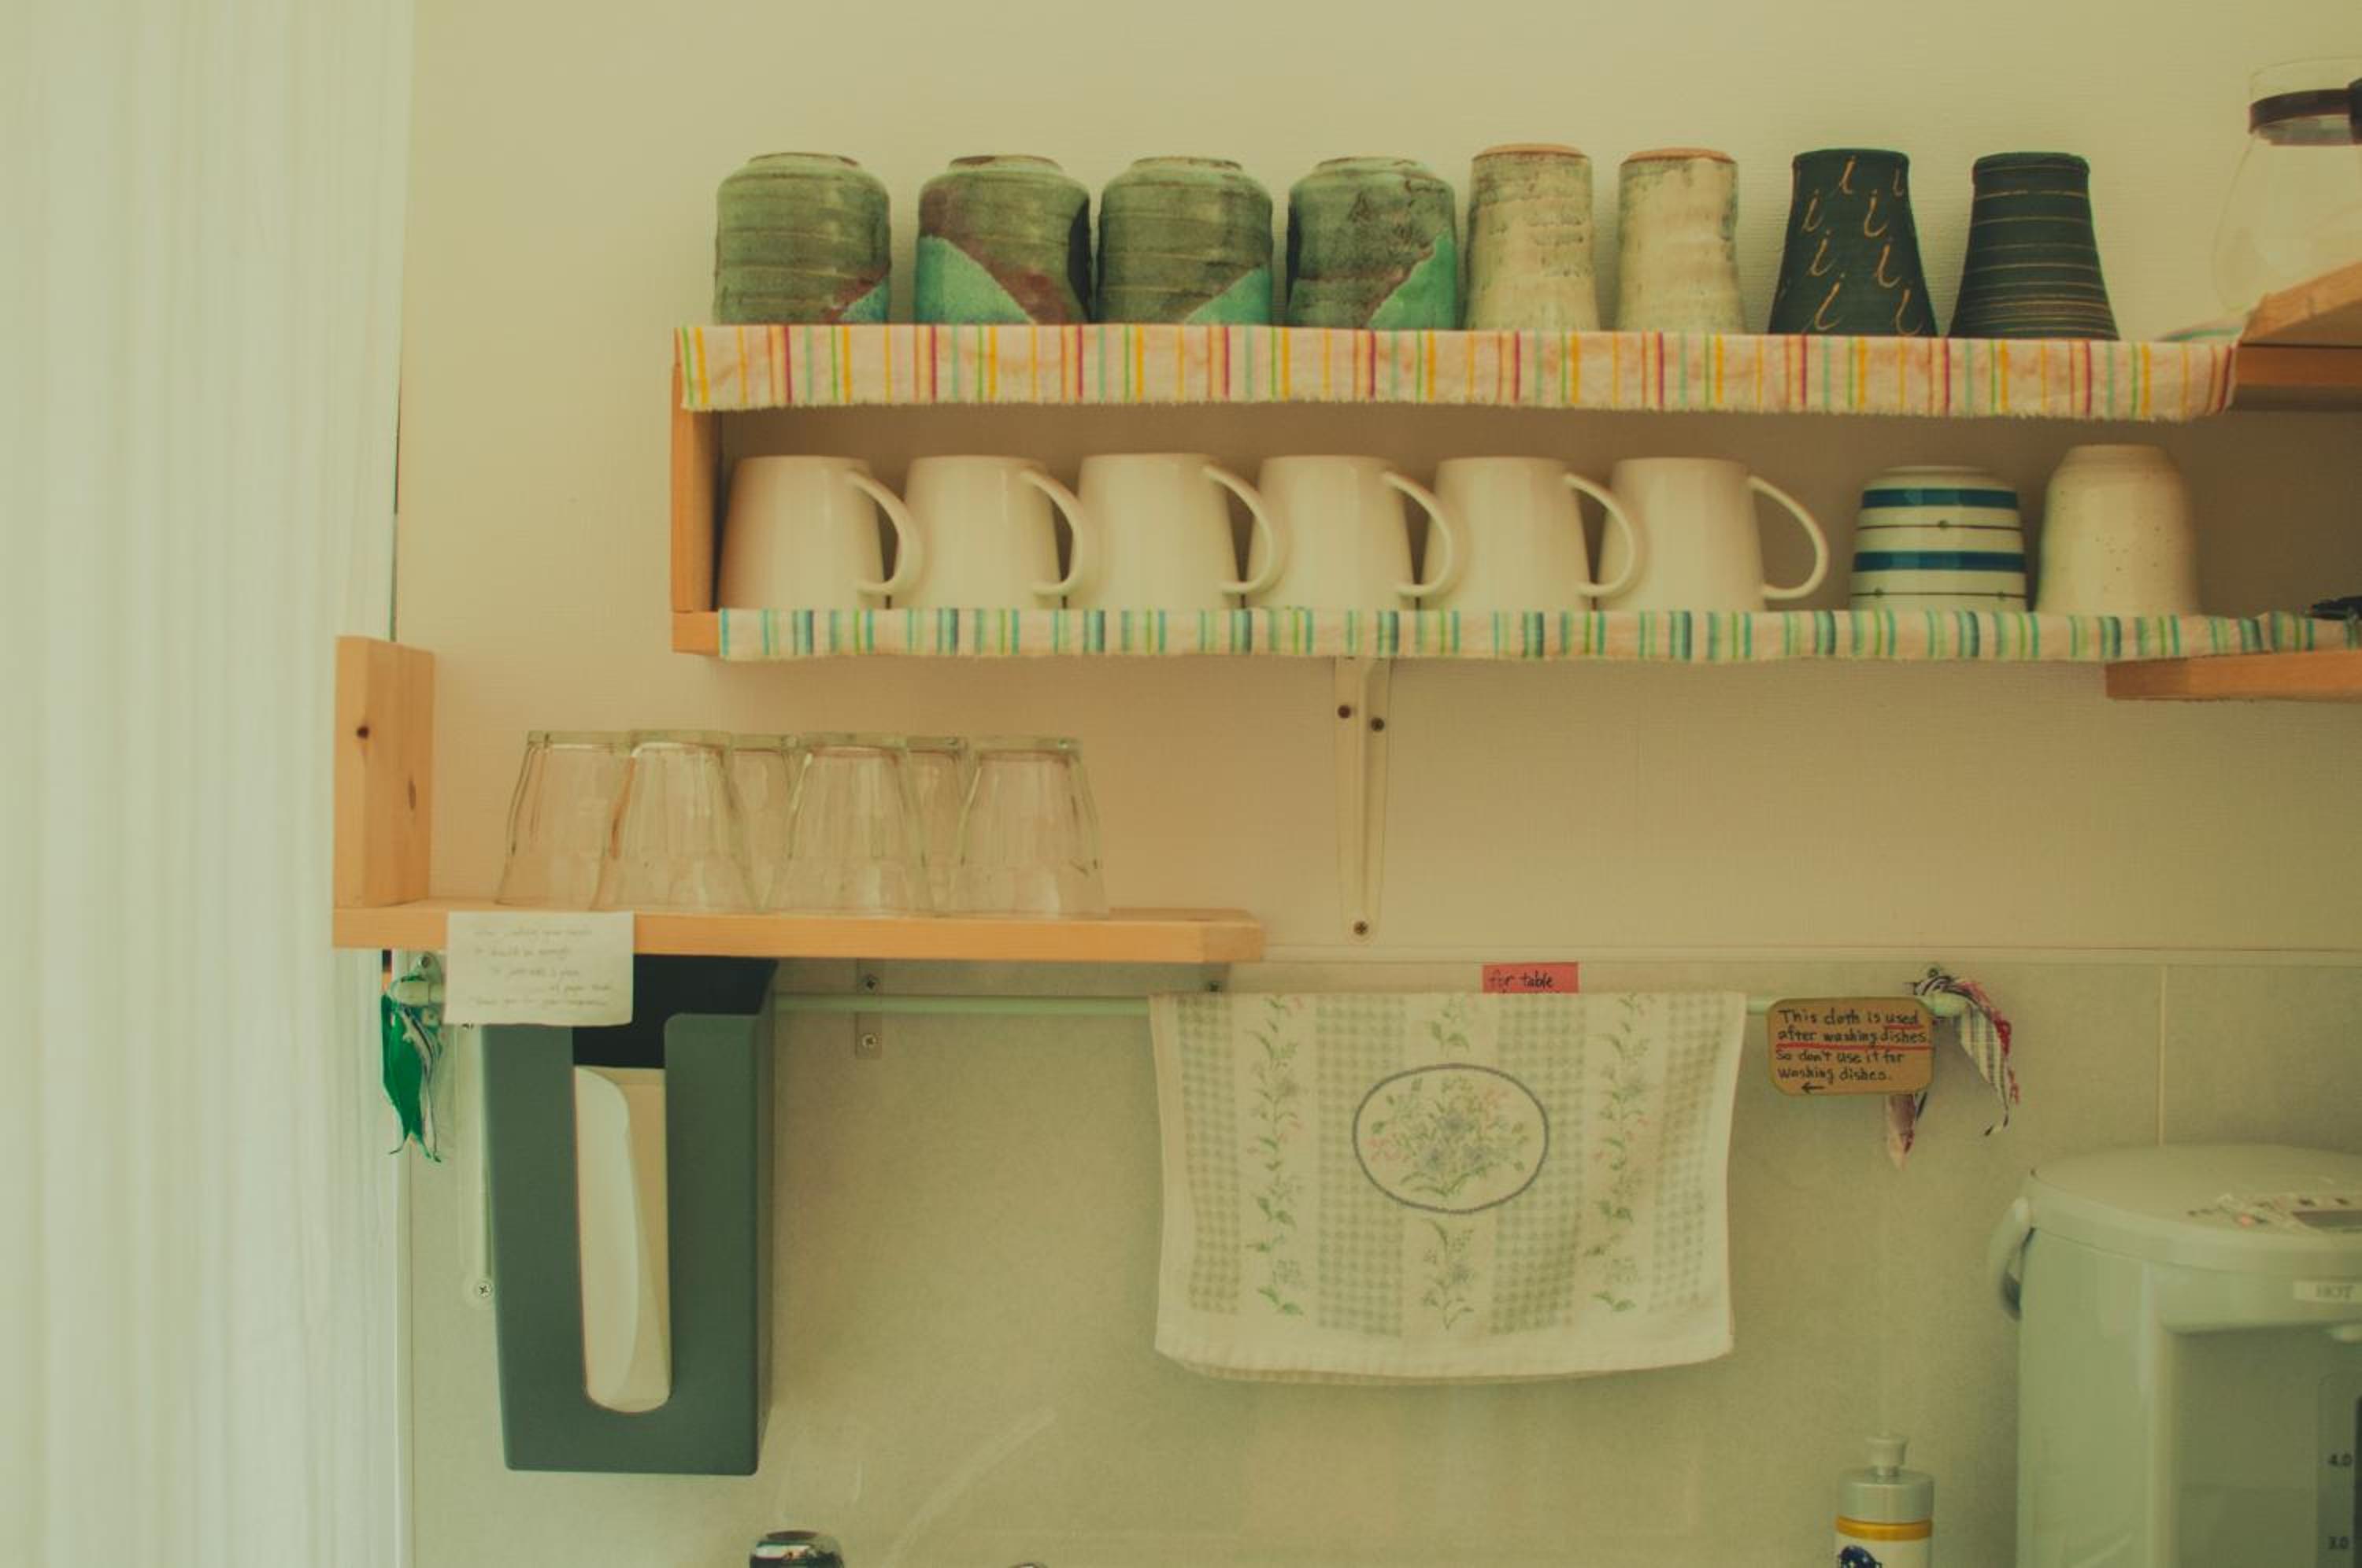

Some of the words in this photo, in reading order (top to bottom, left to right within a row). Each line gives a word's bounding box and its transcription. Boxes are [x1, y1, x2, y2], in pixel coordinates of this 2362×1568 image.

[1519, 969, 1553, 989] table
[1778, 1010, 1817, 1023] This
[1824, 1008, 1860, 1023] cloth
[1867, 1010, 1880, 1023] is
[1886, 1011, 1919, 1024] used
[1778, 1026, 1817, 1041] after
[1823, 1029, 1877, 1046] washing
[1880, 1028, 1927, 1043] dishes
[1776, 1049, 1792, 1060] So
[1866, 1050, 1879, 1062] it
[1883, 1052, 1905, 1063] for
[2328, 1453, 2353, 1468] 4.0
